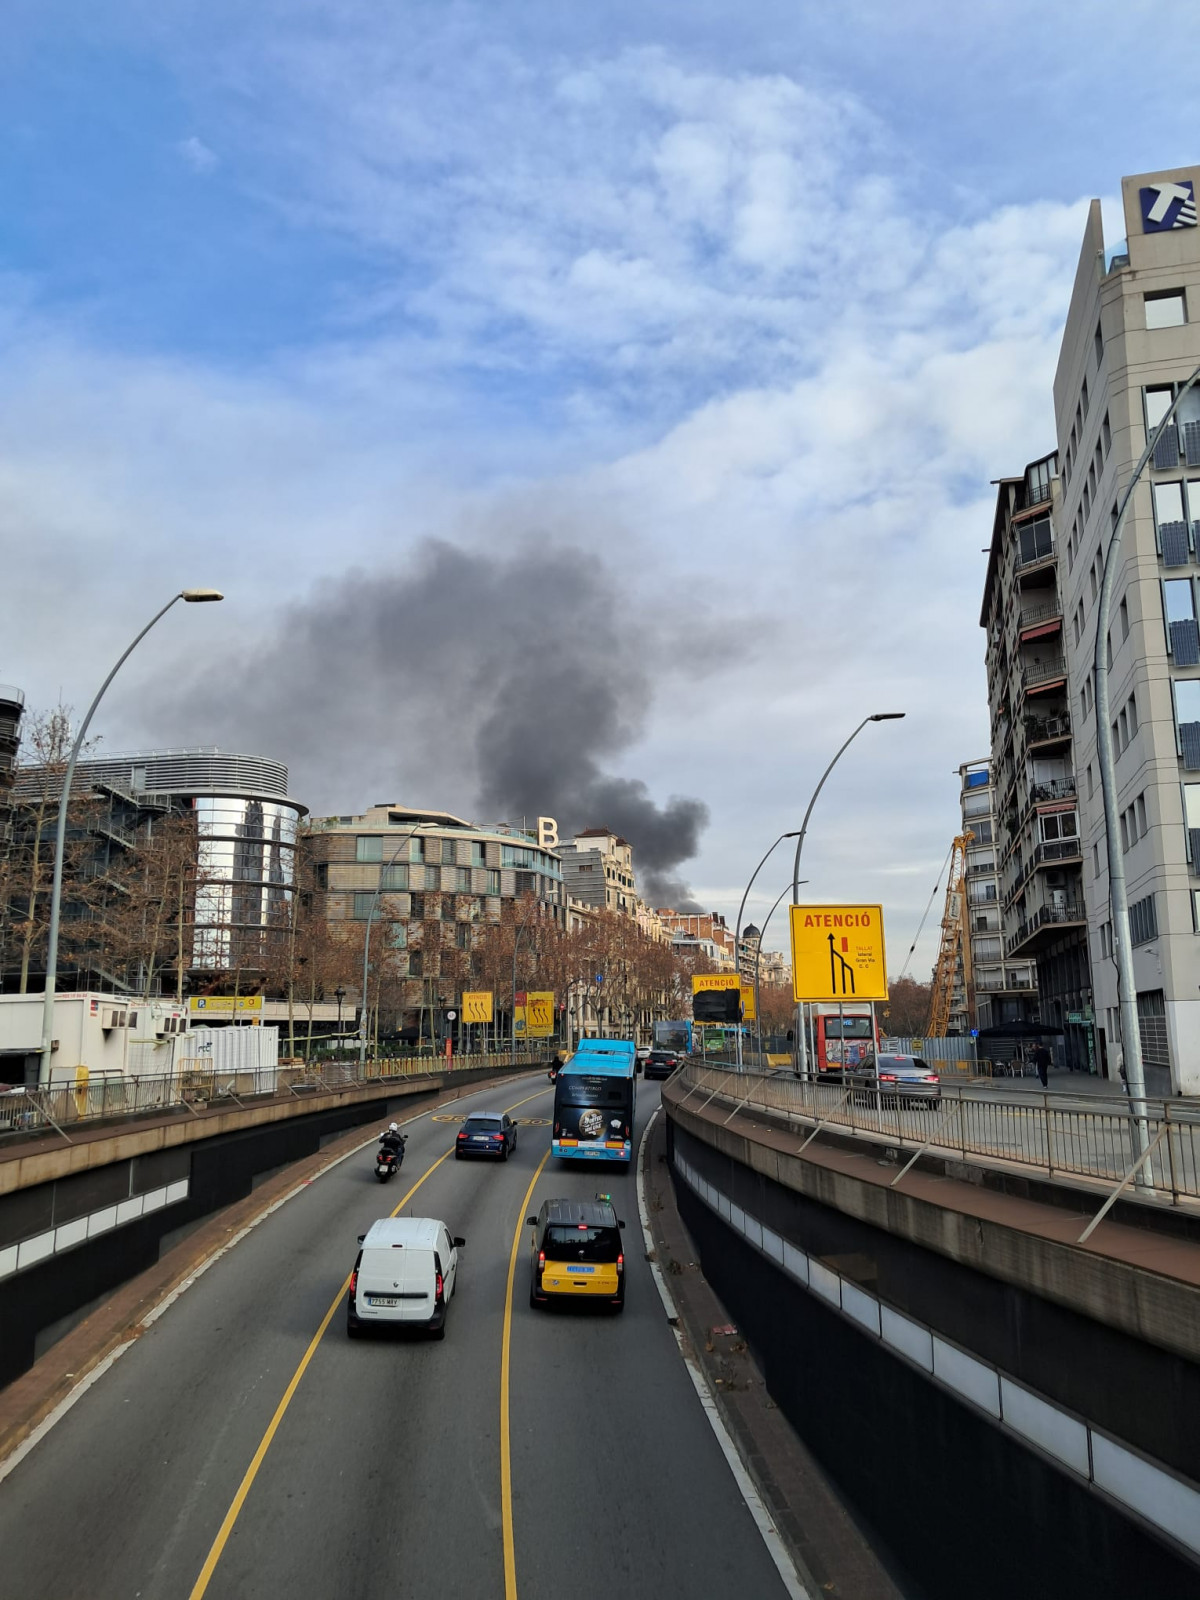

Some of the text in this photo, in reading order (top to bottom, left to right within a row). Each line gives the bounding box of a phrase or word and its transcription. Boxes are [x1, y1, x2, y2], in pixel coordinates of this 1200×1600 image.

[537, 816, 559, 849] B
[804, 911, 870, 928] ATENCIÓ
[699, 978, 734, 987] ATENCIÓ
